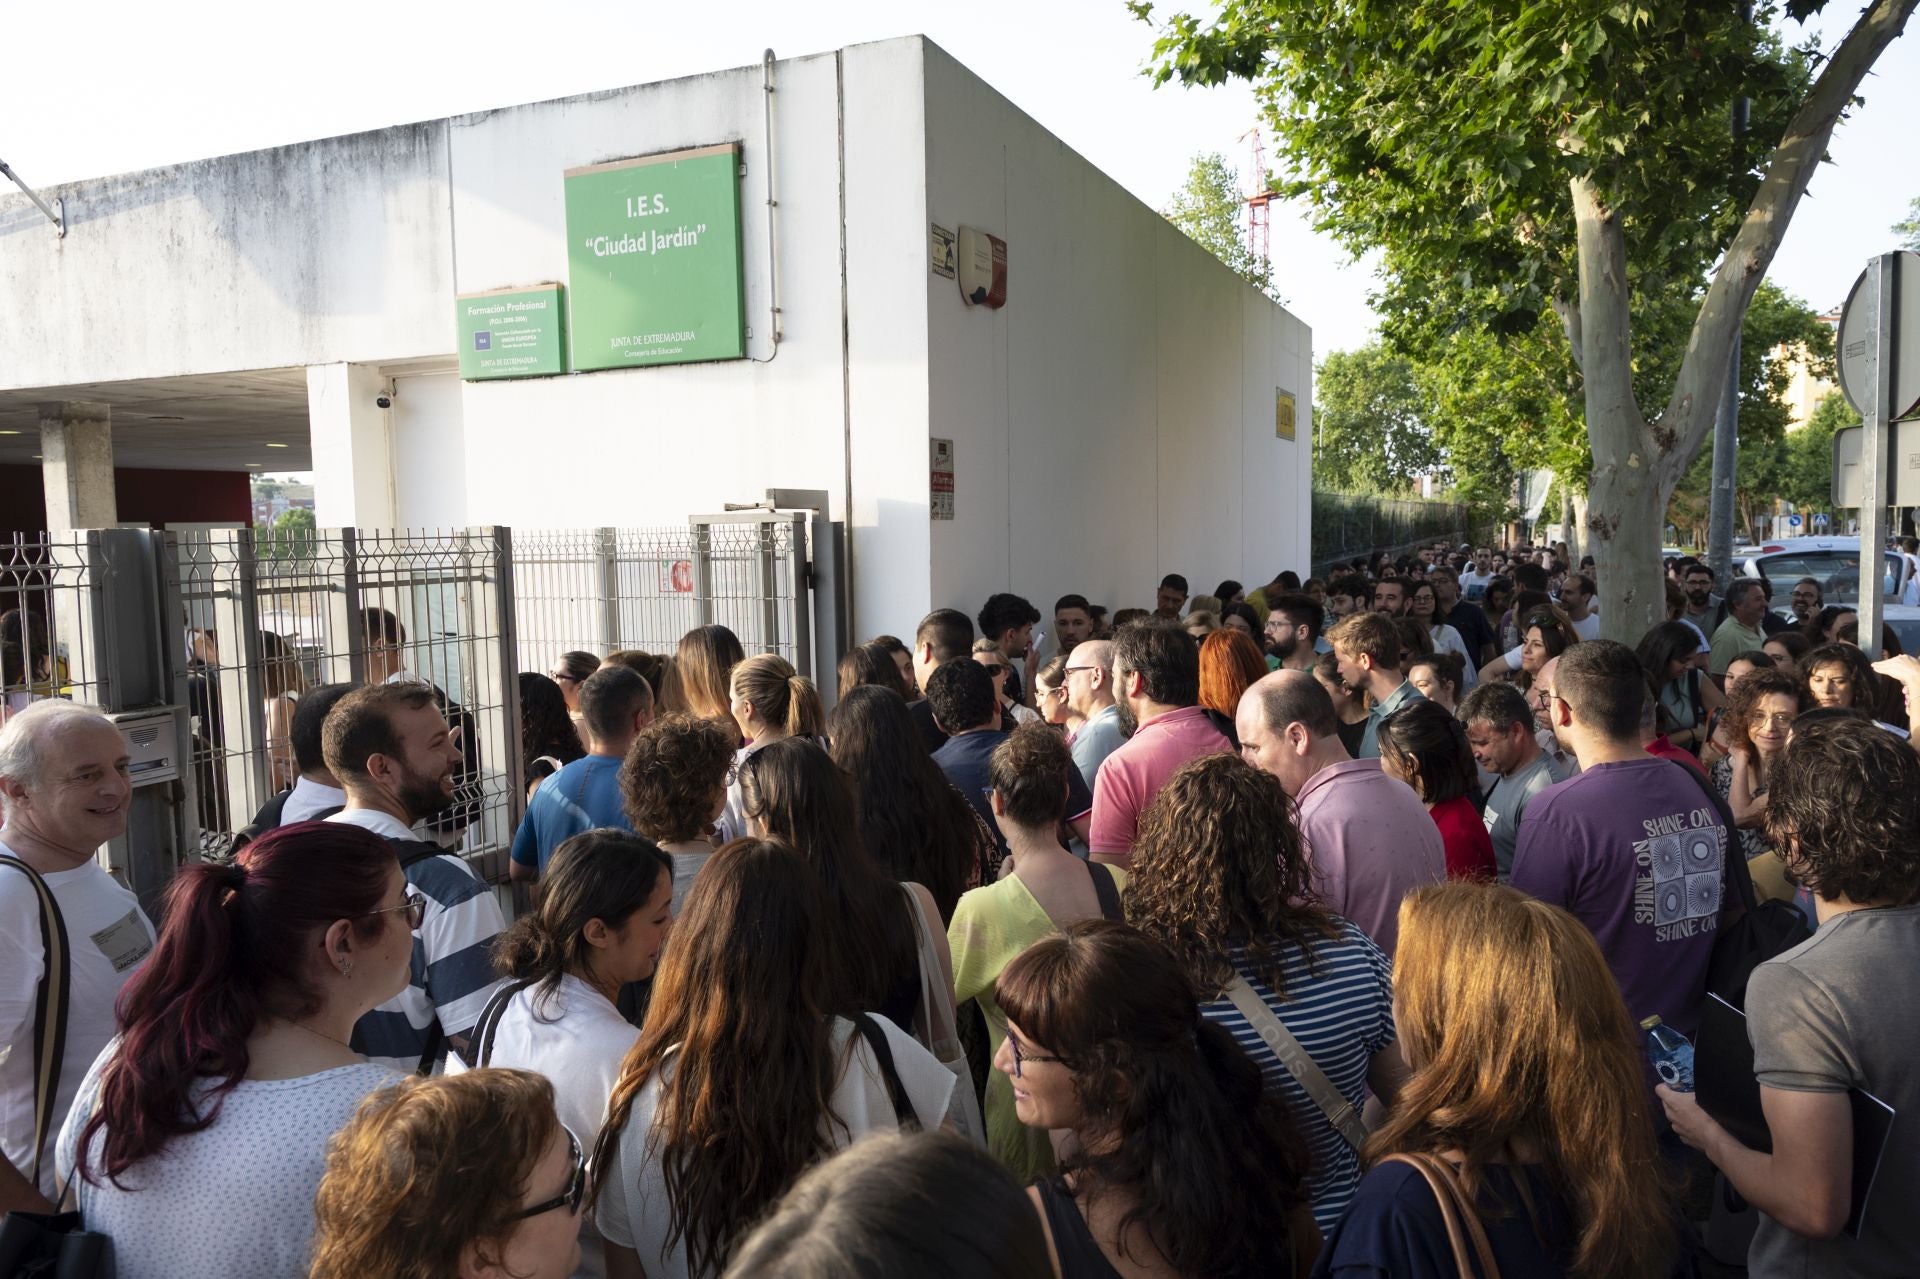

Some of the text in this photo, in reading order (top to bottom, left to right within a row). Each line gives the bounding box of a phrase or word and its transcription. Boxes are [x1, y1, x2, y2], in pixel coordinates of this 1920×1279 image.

[626, 193, 669, 218] I.E.S.
[467, 299, 547, 316] Formación Profesional
[611, 330, 696, 349] JUNTA DE EXTREMADURA
[657, 346, 683, 356] Educación
[1642, 807, 1714, 838] SHINE ON
[1632, 839, 1655, 925] SHINE ON
[1655, 914, 1718, 942] SHINE ON
[1250, 1006, 1308, 1077] TOUS
